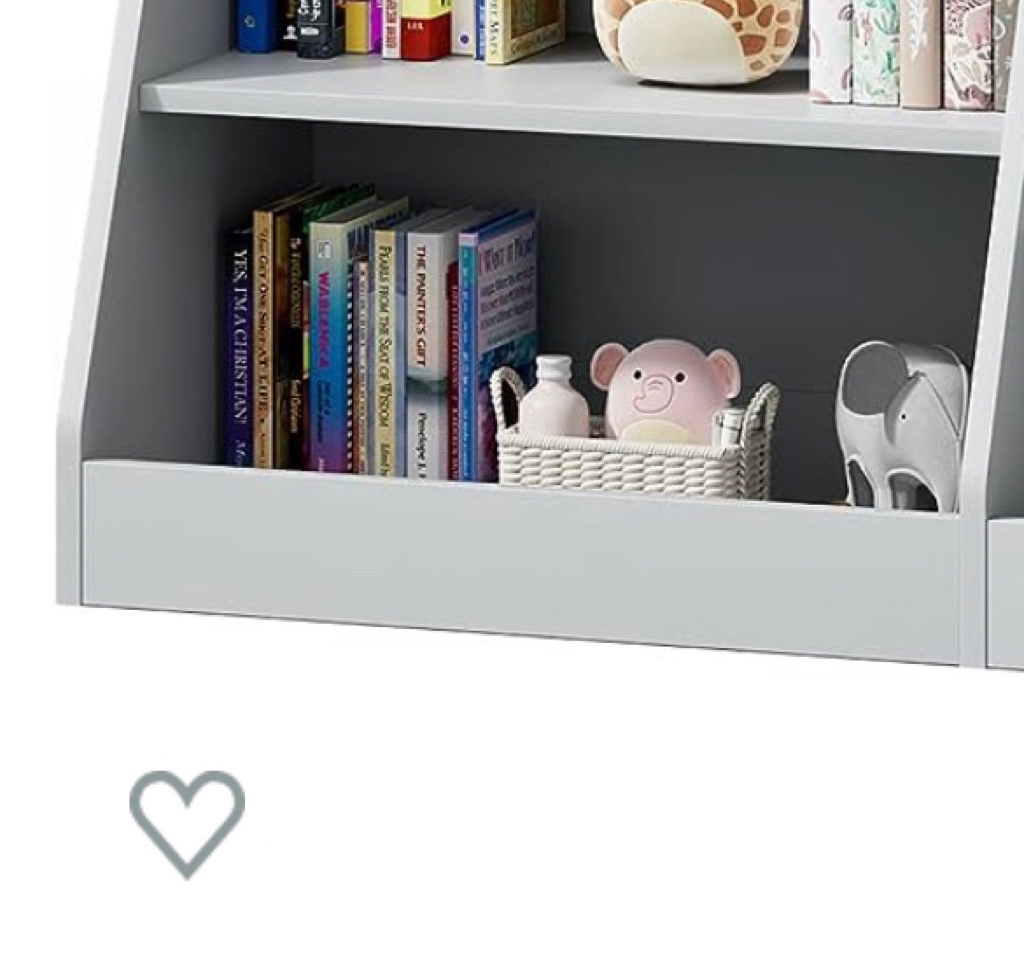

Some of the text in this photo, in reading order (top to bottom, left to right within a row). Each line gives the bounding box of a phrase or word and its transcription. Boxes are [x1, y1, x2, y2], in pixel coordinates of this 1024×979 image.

[233, 249, 247, 425] YES, I'M A CHRISTIAN!
[379, 245, 392, 428] PEARLS FROM THE SEAT OF WISDOM
[416, 245, 426, 367] THE PAINTER'S GIFT
[415, 413, 428, 461] Penelope
